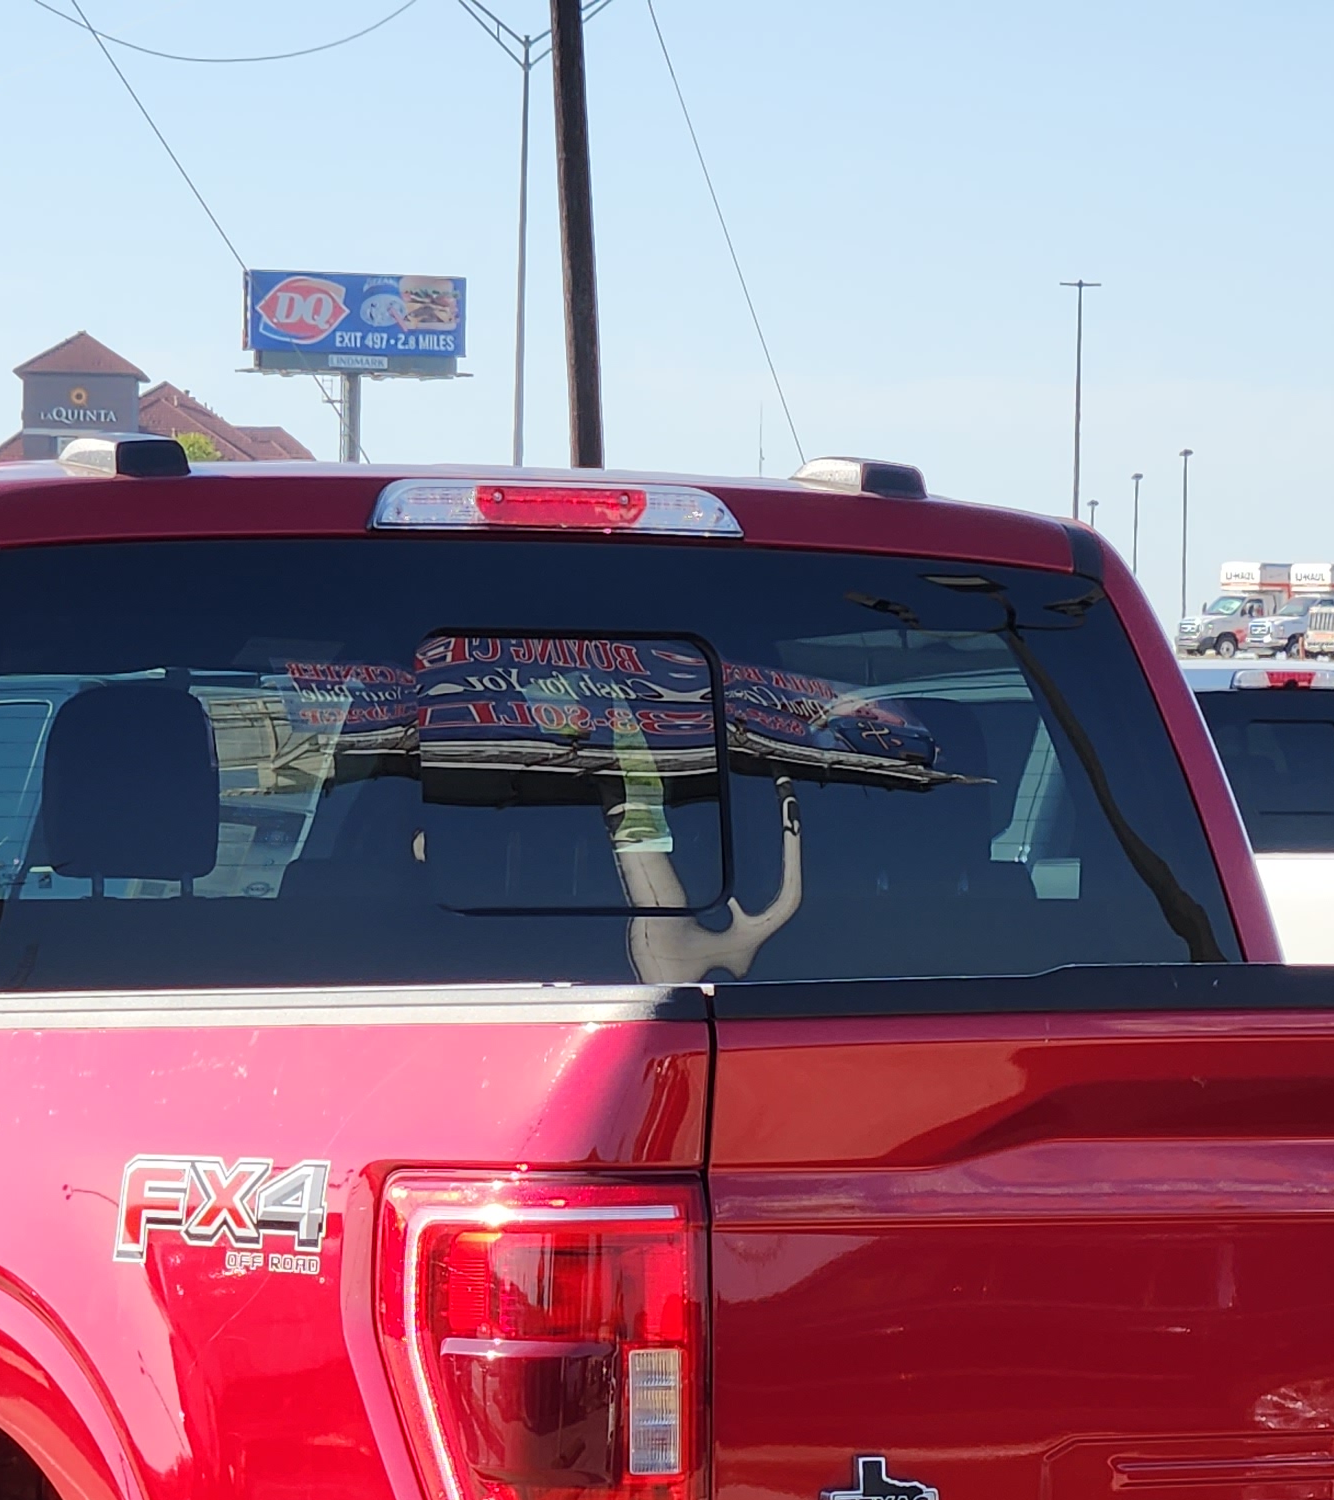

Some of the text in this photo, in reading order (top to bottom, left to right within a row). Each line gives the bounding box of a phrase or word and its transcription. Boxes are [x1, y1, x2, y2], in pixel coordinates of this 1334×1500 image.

[275, 292, 335, 328] DQ
[335, 331, 454, 351] EXIT 497 2.8 MILES
[329, 355, 386, 368] LINDMARK
[52, 406, 117, 424] QUINTA
[113, 1154, 331, 1263] FX4
[225, 1251, 322, 1275] OFF ROAD
